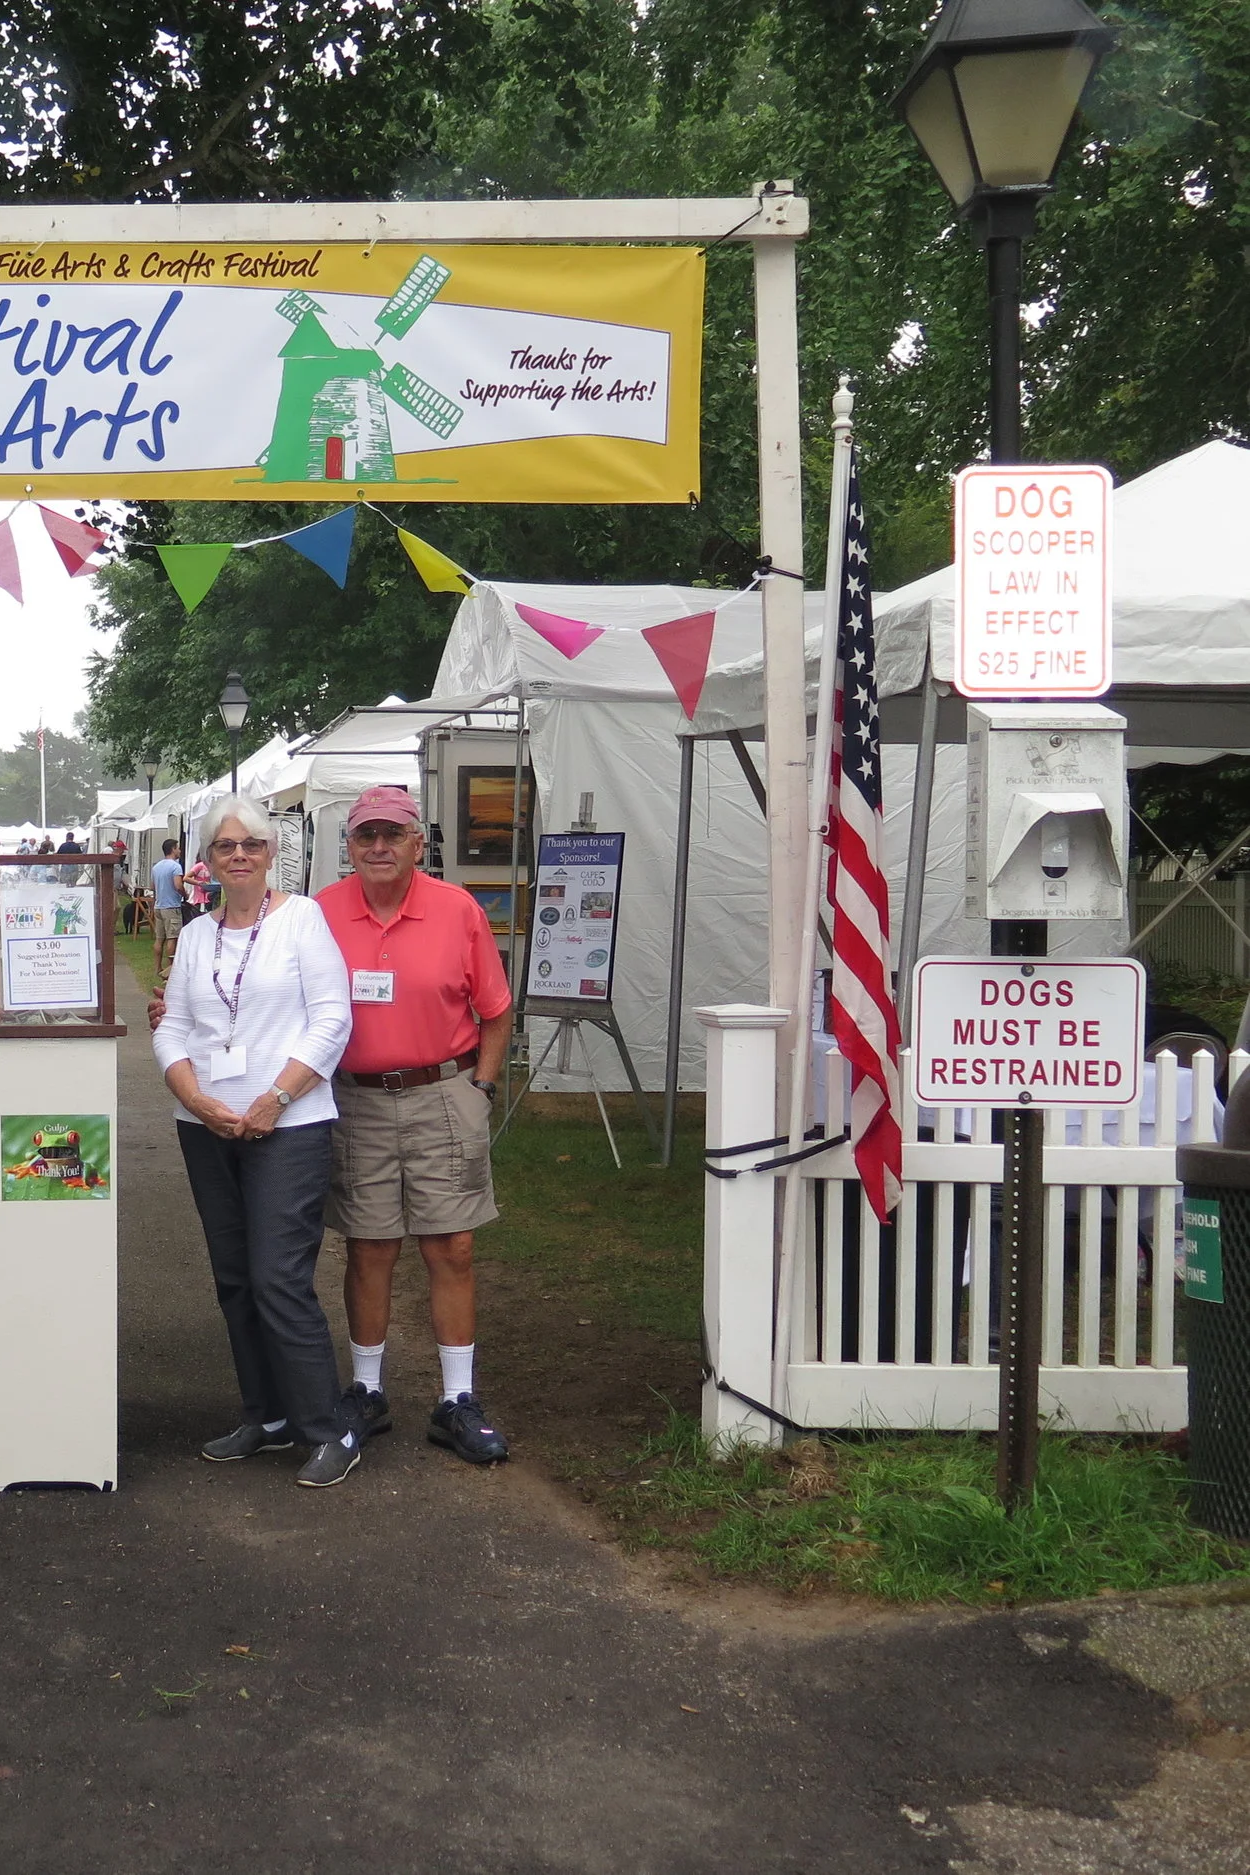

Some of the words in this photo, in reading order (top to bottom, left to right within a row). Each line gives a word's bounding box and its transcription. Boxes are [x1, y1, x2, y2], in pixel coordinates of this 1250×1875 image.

[51, 251, 106, 280] Arts
[113, 254, 130, 278] &
[140, 250, 215, 284] Crafts
[223, 250, 322, 279] Festival
[510, 345, 577, 370] Thanks
[581, 347, 612, 375] for
[459, 378, 567, 411] Supporting
[571, 376, 603, 401] the
[606, 378, 656, 403] Arts!
[995, 486, 1073, 518] DOG
[973, 530, 1095, 555] SCOOPER
[988, 570, 1041, 595] LAW
[1056, 570, 1079, 595] IN
[985, 610, 1080, 635] EFFECT
[1034, 650, 1087, 675] FINE
[546, 837, 571, 848] Thank
[571, 839, 588, 850] you
[590, 838, 598, 847] to
[599, 838, 616, 847] our
[559, 852, 600, 865] Sponsors!
[17, 953, 50, 961] Suggested
[36, 941, 61, 951] $3.00
[534, 980, 571, 990] ROCKLAND
[980, 979, 1075, 1007] DOGS
[953, 1019, 1041, 1046] MUST
[1058, 1020, 1100, 1047] BE
[931, 1058, 1122, 1087] RESTRAINED
[43, 1123, 69, 1134] Gulp!
[36, 1165, 61, 1178] Thank
[61, 1165, 80, 1178] You!
